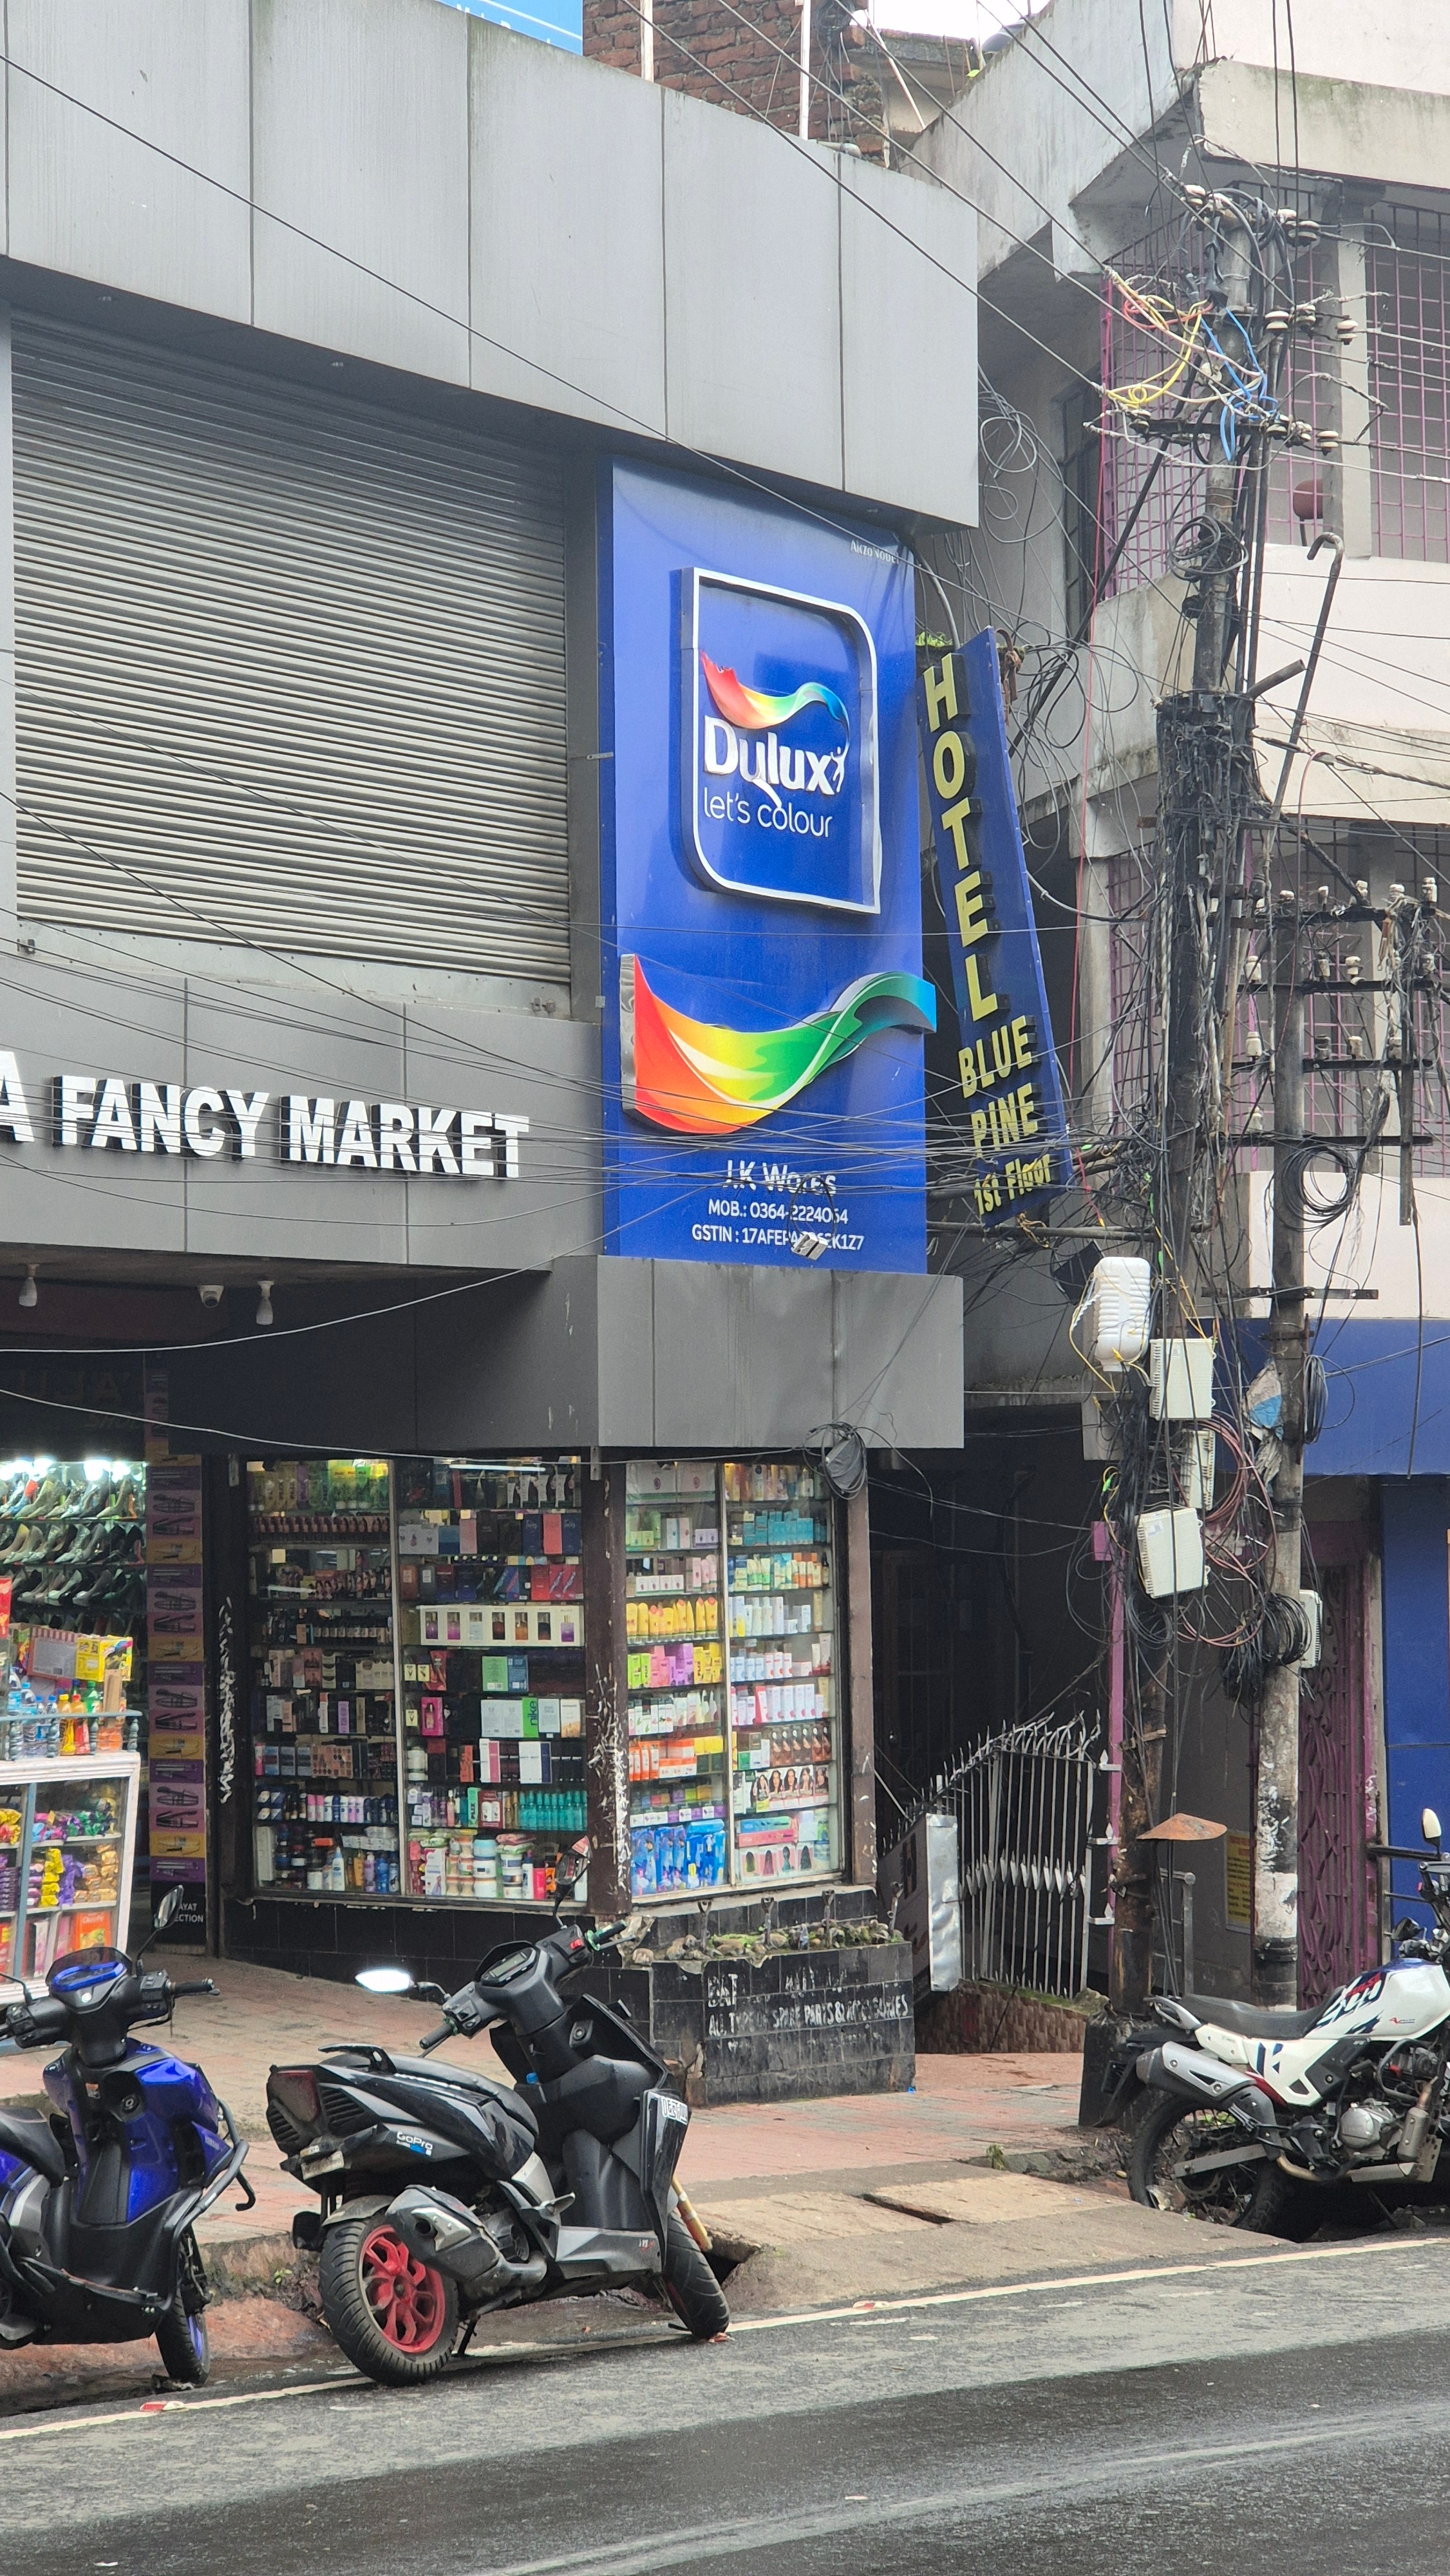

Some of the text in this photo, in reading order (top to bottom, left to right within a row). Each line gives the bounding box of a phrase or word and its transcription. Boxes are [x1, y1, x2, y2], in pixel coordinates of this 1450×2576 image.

[704, 715, 836, 805] Dulux
[704, 786, 833, 838] let's colour
[923, 652, 997, 1022] HOTEL
[958, 1015, 1033, 1099] BLUE
[59, 1074, 269, 1159] FANCY
[287, 1095, 530, 1178] MARKET
[971, 1082, 1039, 1159] PINE
[974, 1153, 1051, 1216] 1st Floor
[692, 1223, 732, 1243] GSTIN
[527, 1700, 538, 1726] nike
[180, 1903, 198, 1911] AYAT
[397, 2131, 433, 2150] GoPro
